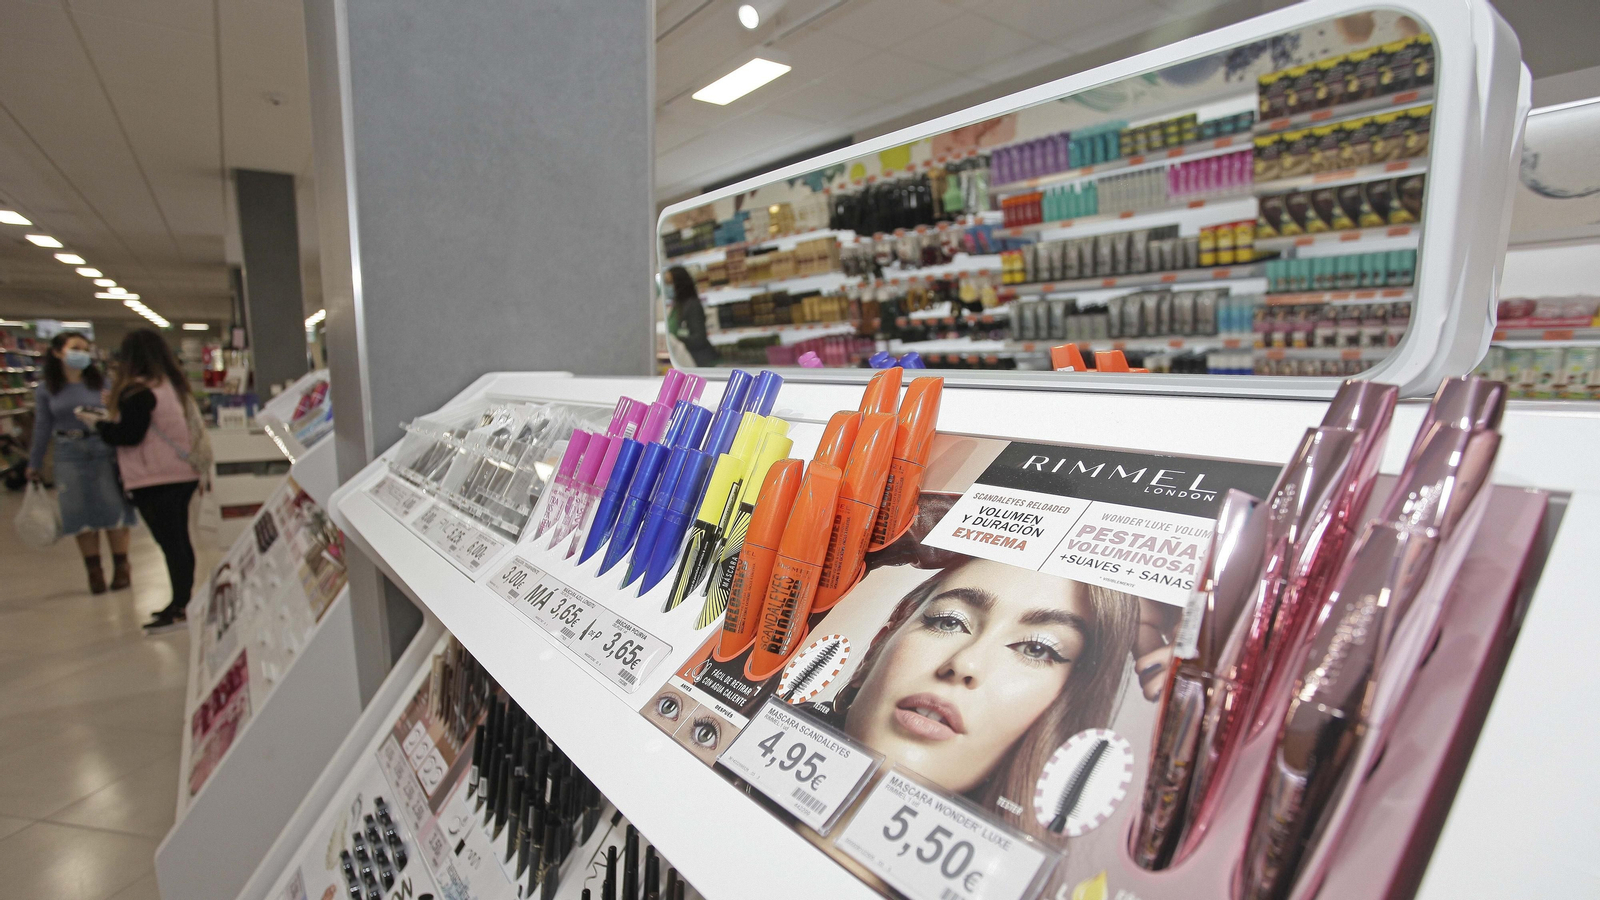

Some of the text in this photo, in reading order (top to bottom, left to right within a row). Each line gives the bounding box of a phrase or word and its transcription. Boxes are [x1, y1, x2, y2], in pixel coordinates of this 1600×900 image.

[1022, 455, 1217, 493] RIMMEL
[973, 492, 1070, 515] SCANDALEYES RELOADED
[1144, 486, 1215, 501] LONDON
[962, 514, 1045, 538] Y DURACIÓN
[979, 506, 1044, 525] VOLUMEN
[1101, 513, 1214, 539] WONDER'LUXE VOLUM
[952, 527, 1027, 551] EXTREMA
[1067, 539, 1199, 576] VOLUMINOSA
[502, 566, 528, 590] 3,00€
[1139, 570, 1195, 591] SANAS
[550, 598, 584, 628] 3,65€
[761, 573, 795, 651] SCANDALEYES
[766, 580, 804, 656] RELOADED
[602, 632, 644, 671] 3,65€
[680, 683, 693, 693] ANTES
[702, 676, 748, 707] CON AGUA CALIENTE
[711, 668, 724, 682] FÁCIL
[731, 678, 752, 696] RETIRAR
[714, 704, 734, 719] DESPUÉS
[813, 702, 831, 715] TESTER
[767, 707, 852, 759] MASCARA SCANDALEYES
[757, 731, 827, 791] 4,95€
[889, 776, 934, 807] MASCARA
[981, 828, 1013, 851] LUXE
[882, 804, 984, 893] 5,50€
